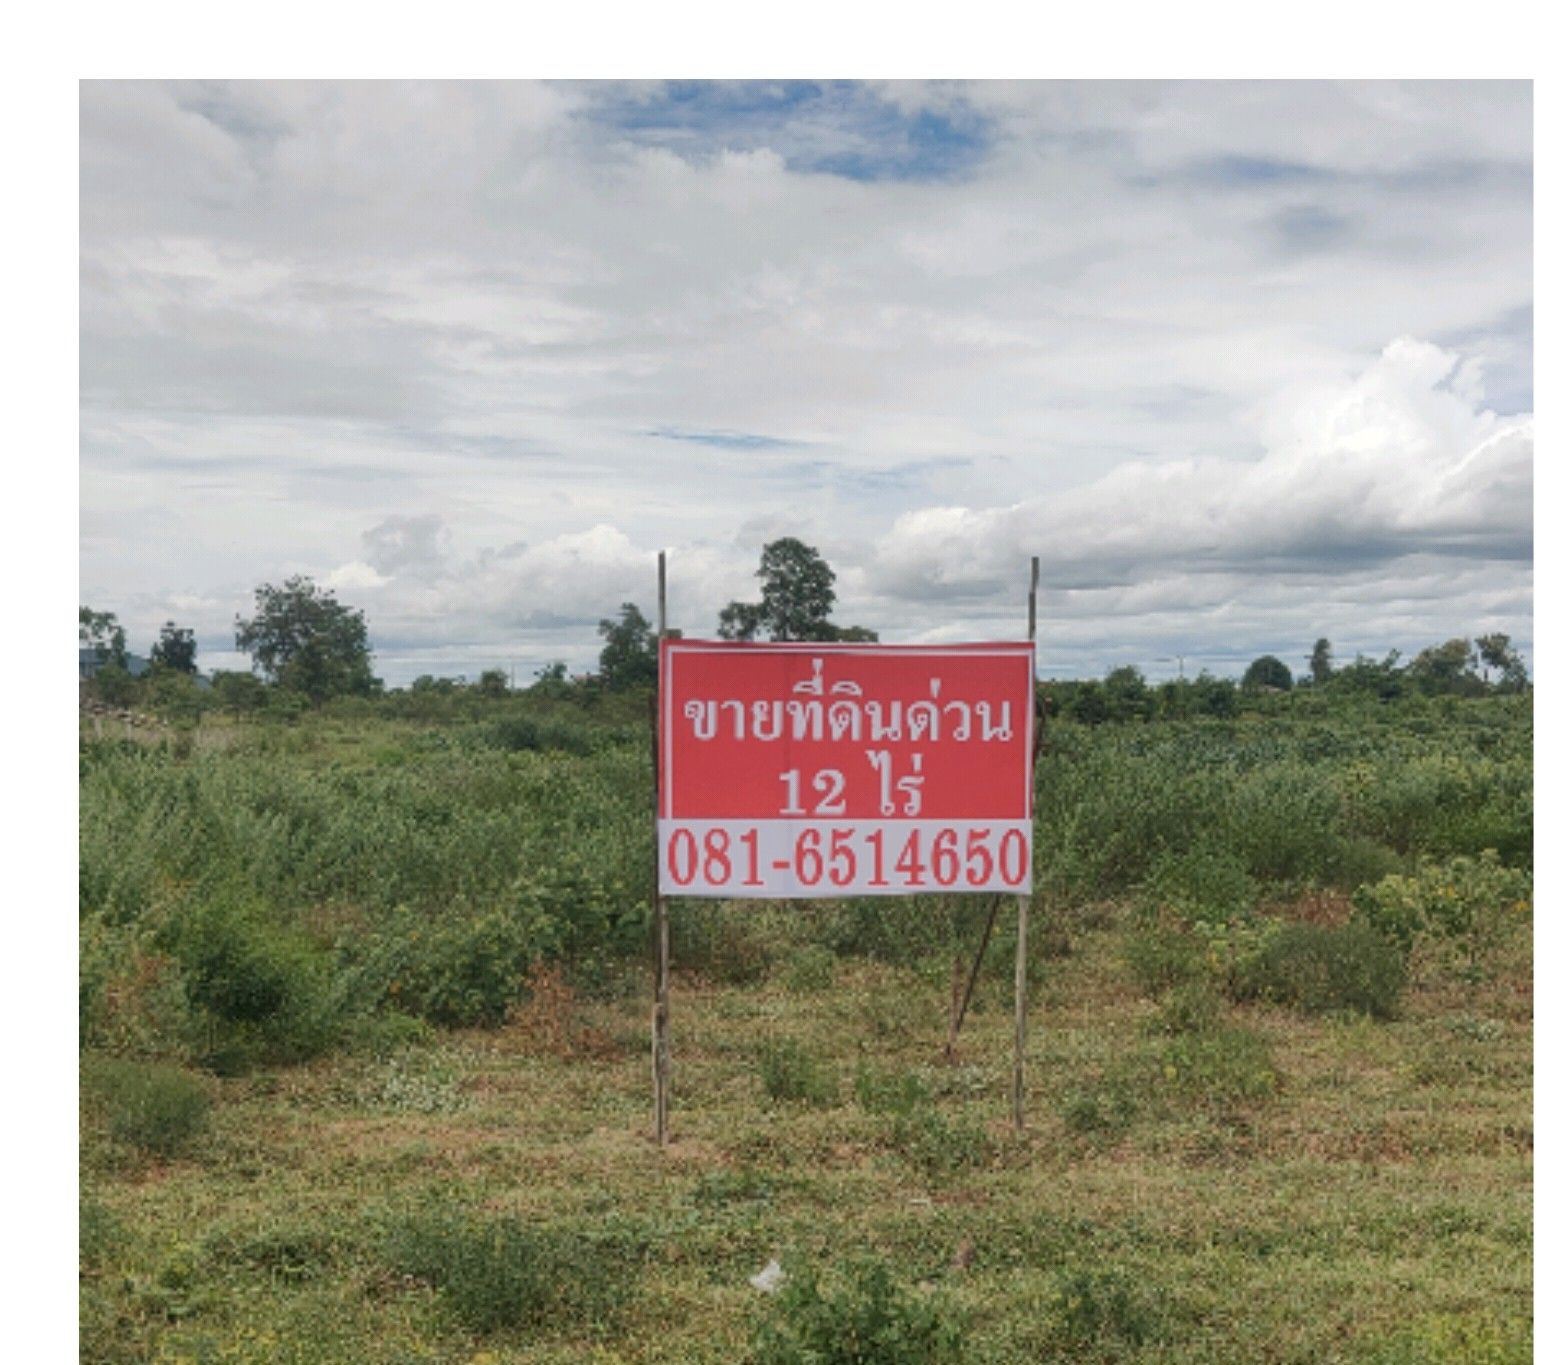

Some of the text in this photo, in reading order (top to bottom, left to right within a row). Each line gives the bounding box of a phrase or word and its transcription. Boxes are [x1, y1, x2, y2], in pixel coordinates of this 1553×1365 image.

[684, 657, 1013, 742] ขายที่ดินด่วน
[778, 749, 926, 817] 12 ไร่
[667, 827, 1028, 887] 081-6514650
